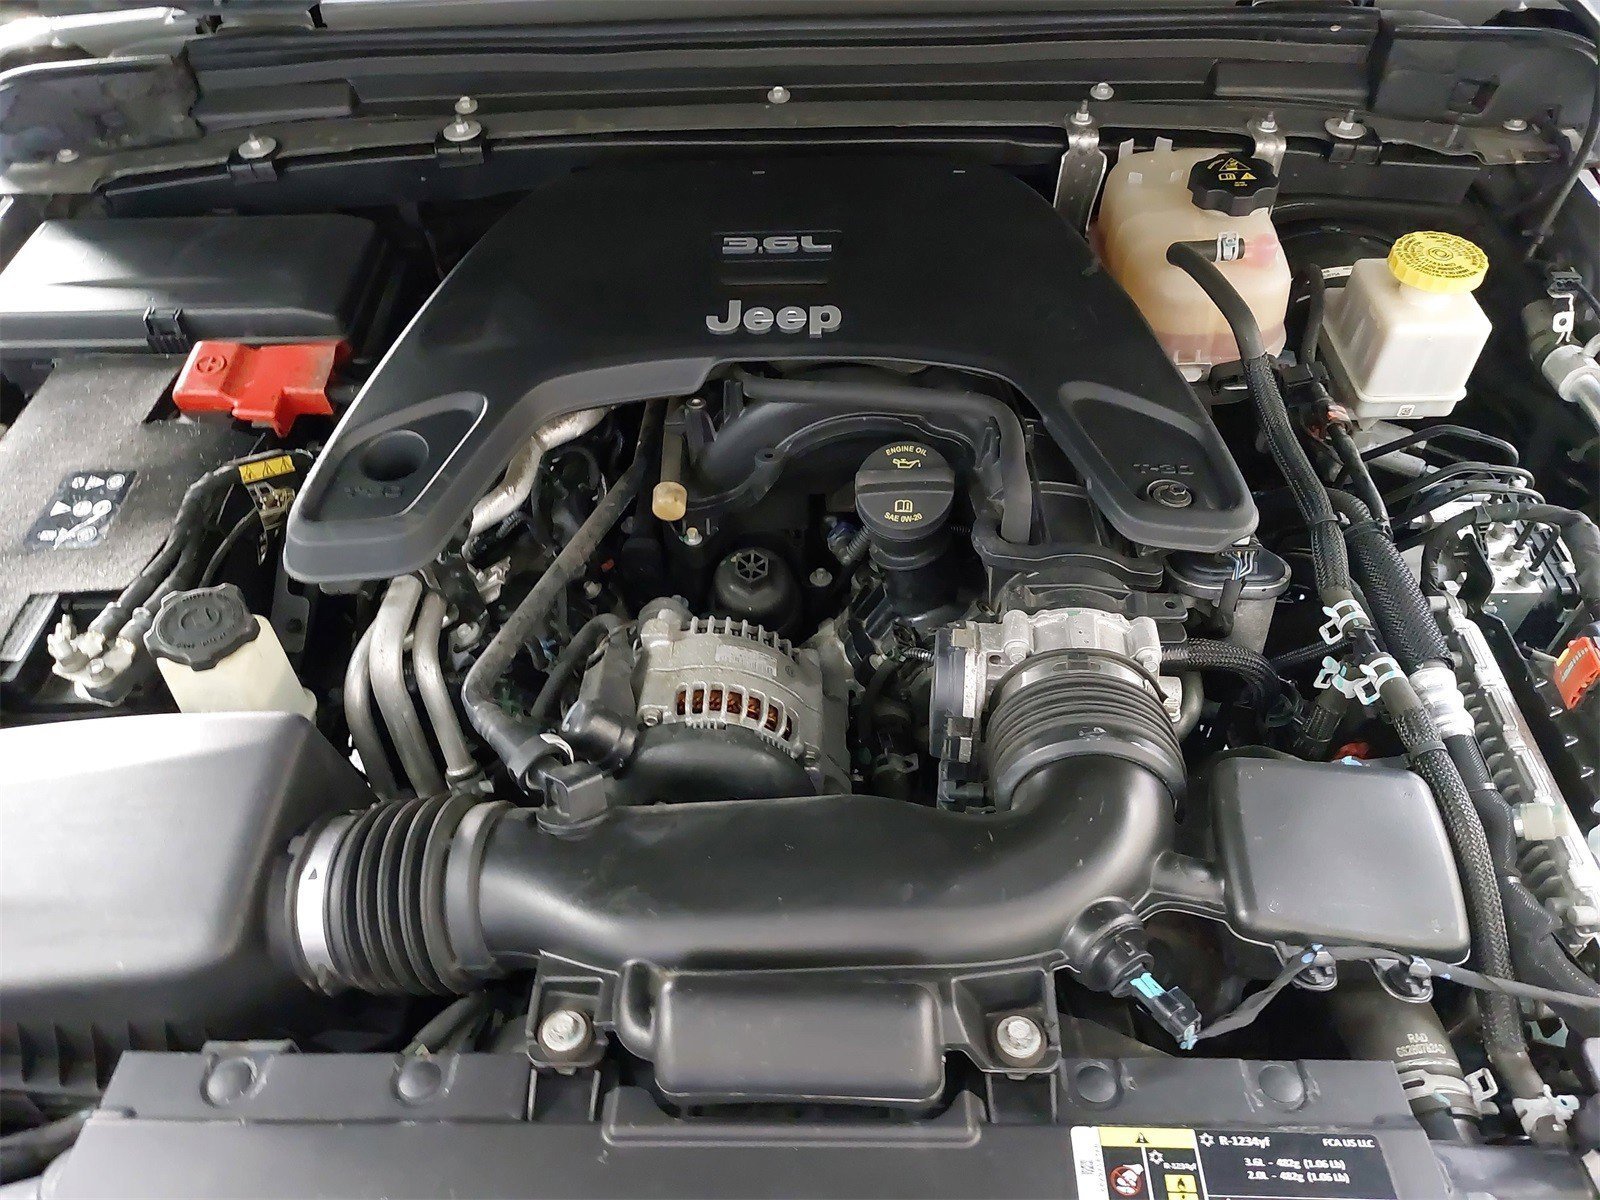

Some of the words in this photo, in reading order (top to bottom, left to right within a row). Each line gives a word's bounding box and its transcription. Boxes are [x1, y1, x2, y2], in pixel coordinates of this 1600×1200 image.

[722, 236, 832, 254] 3.6L
[706, 300, 842, 338] Jeep
[885, 445, 914, 456] ENGINE
[915, 446, 927, 457] OIL
[884, 511, 899, 522] SAE
[900, 512, 923, 523] 0W-20
[1218, 1135, 1270, 1149] R-1234yf
[1322, 1138, 1342, 1147] FCA
[1341, 1139, 1357, 1148] US
[1356, 1139, 1375, 1148] LLC
